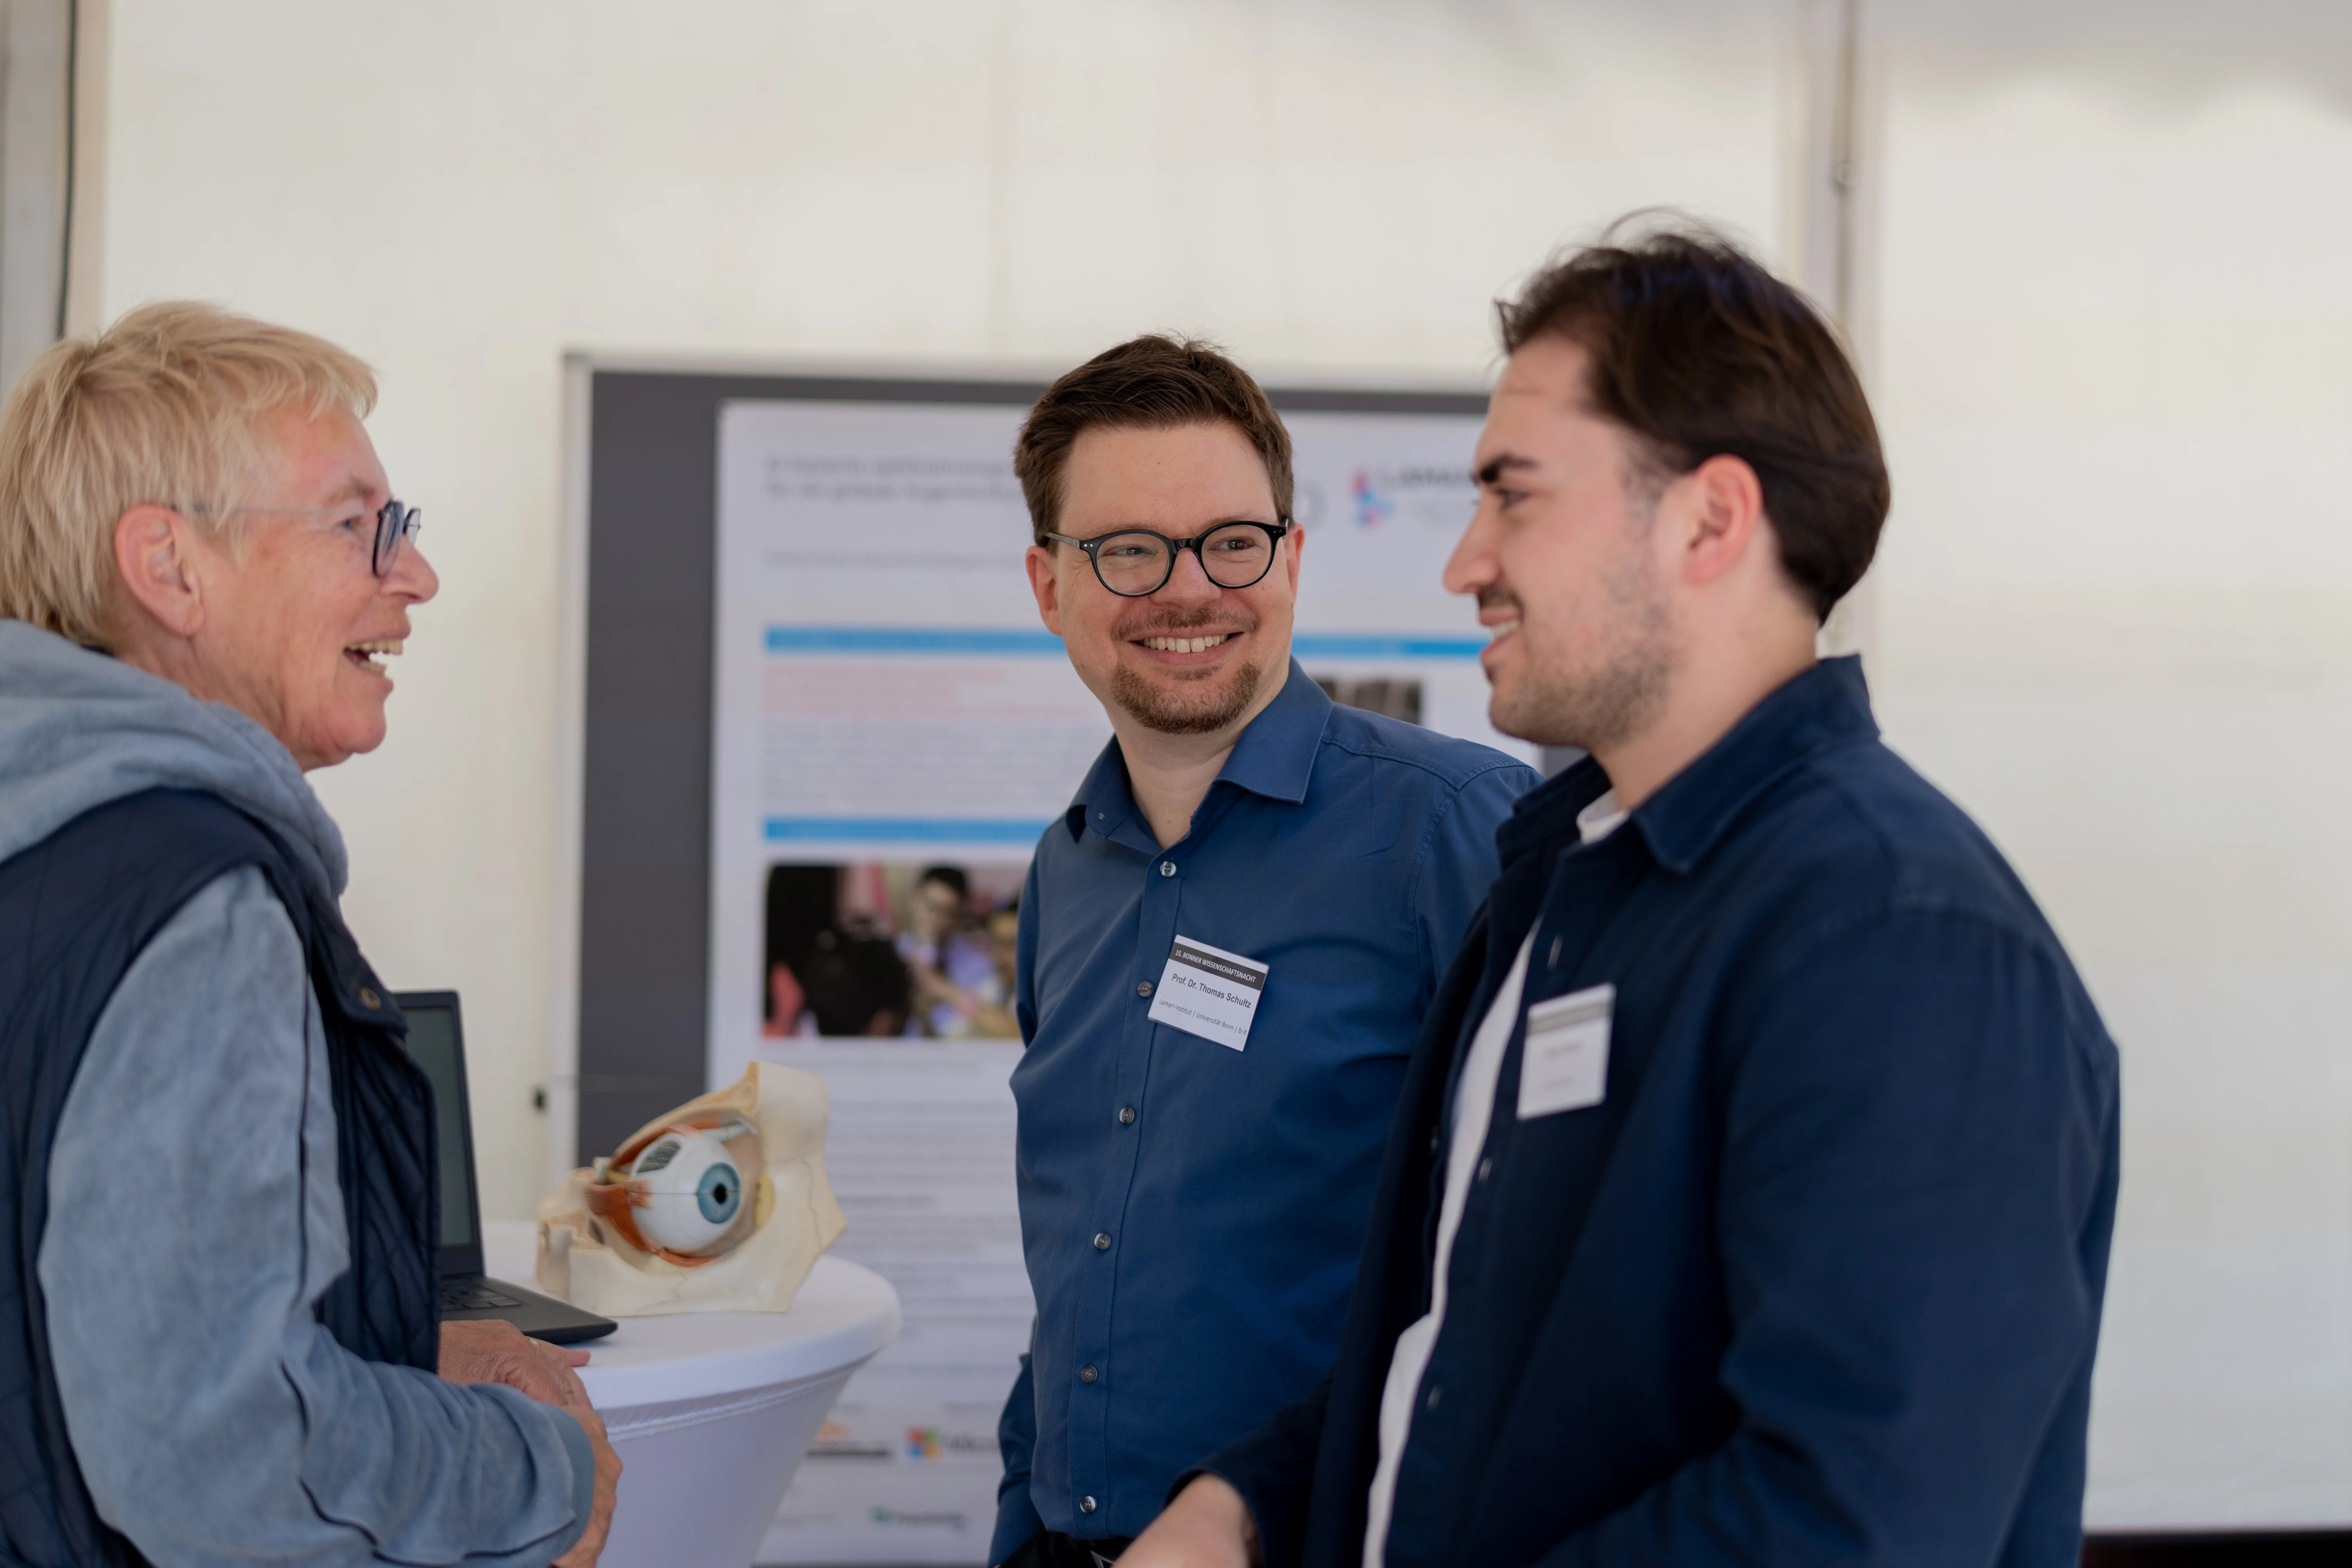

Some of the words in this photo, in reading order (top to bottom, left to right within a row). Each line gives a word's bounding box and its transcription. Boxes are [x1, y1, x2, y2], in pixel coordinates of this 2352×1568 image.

[1182, 952, 1202, 963] BONNER
[1202, 959, 1256, 983] WISSENSCHAFTSNACHT
[1172, 973, 1186, 985] Prof.
[1188, 979, 1197, 989] Dr.
[1200, 983, 1225, 999] Thomas
[1226, 993, 1251, 1008] Schultz
[1159, 999, 1192, 1015] Lamarr-Institut
[1196, 1012, 1221, 1026] Universität
[1221, 1021, 1234, 1031] Bonn
[1238, 1027, 1247, 1036] b-it
